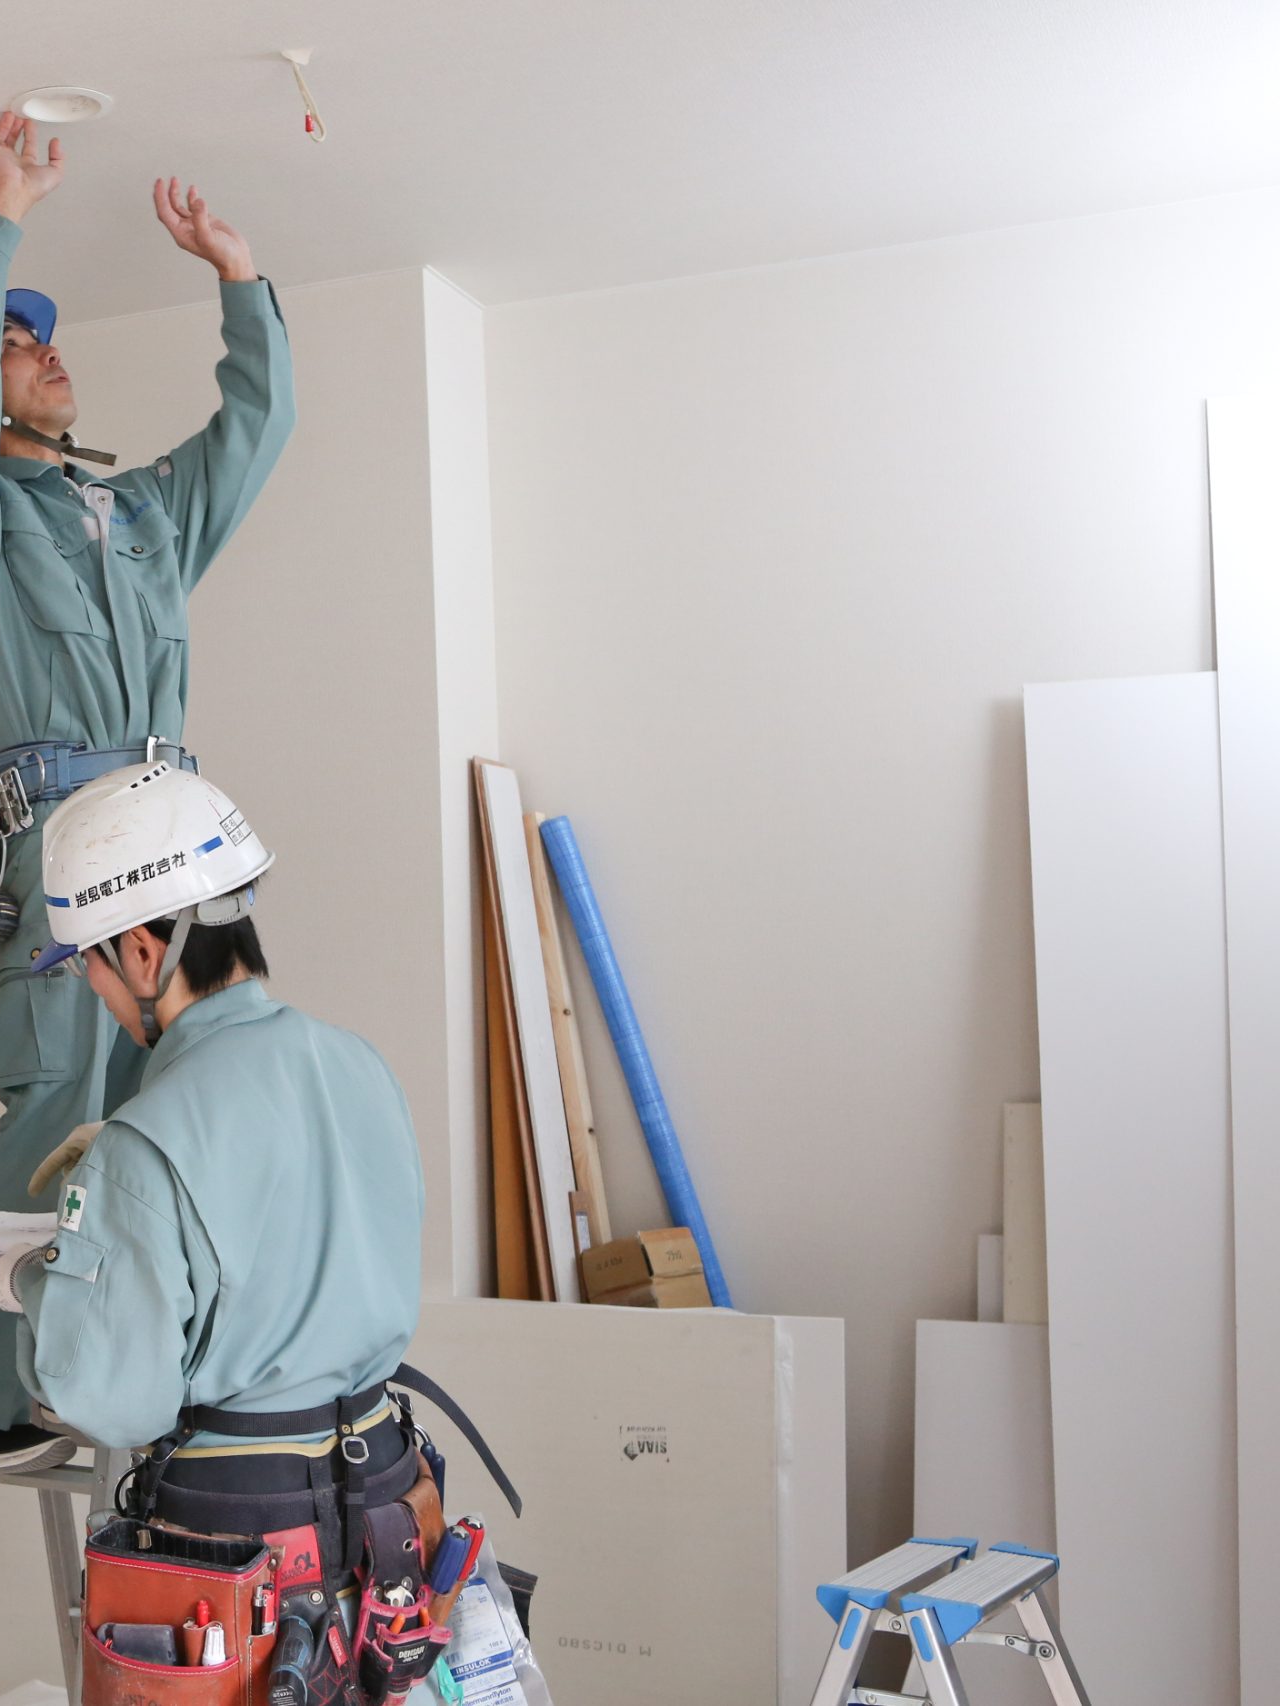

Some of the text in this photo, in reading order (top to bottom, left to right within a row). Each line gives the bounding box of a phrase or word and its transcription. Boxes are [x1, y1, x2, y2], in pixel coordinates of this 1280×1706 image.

[75, 850, 187, 909] 岩見電工株式会社
[455, 1657, 492, 1675] INSULOK
